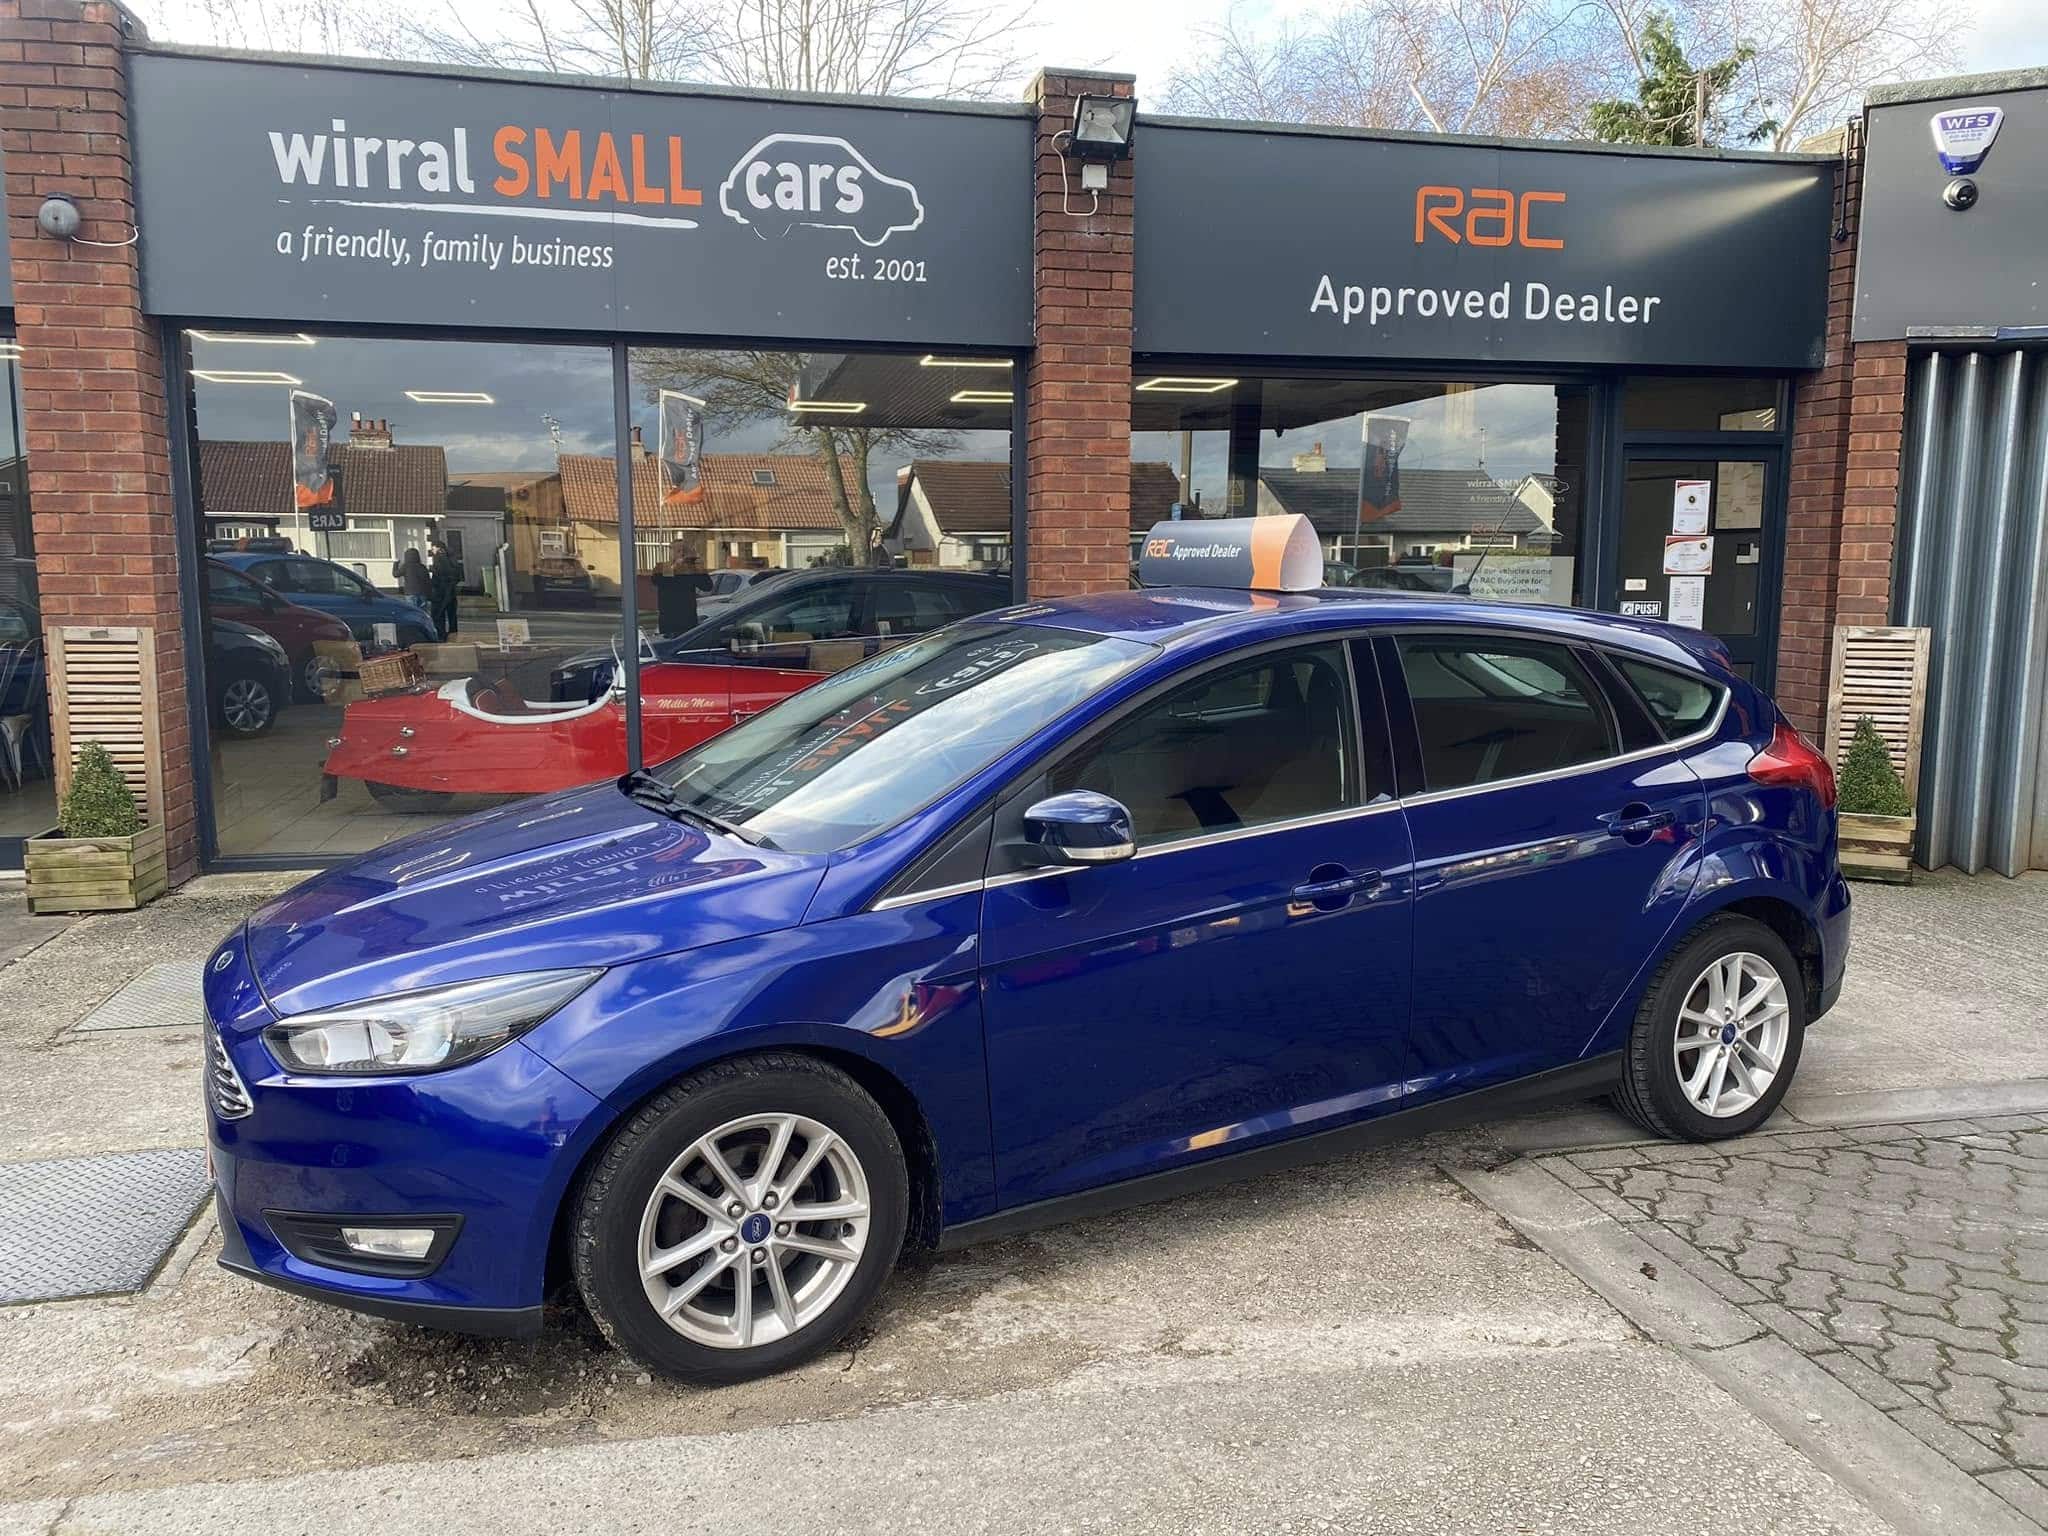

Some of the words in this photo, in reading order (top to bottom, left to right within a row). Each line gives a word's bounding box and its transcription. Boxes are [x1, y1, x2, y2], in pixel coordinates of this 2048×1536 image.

[1946, 115, 1990, 129] WFS
[267, 119, 475, 194] wirral
[493, 126, 703, 206] SMALL
[745, 159, 864, 213] cars
[275, 230, 292, 255] a
[300, 225, 411, 267] friendly,
[420, 231, 504, 271] family
[511, 235, 614, 268] business
[826, 256, 866, 280] est.
[873, 258, 928, 283] 2001
[1310, 274, 1510, 325] Approved
[1524, 282, 1661, 323] Dealer
[1172, 544, 1212, 560] Approved
[1211, 544, 1242, 558] Dealer
[1635, 603, 1659, 614] PUSH
